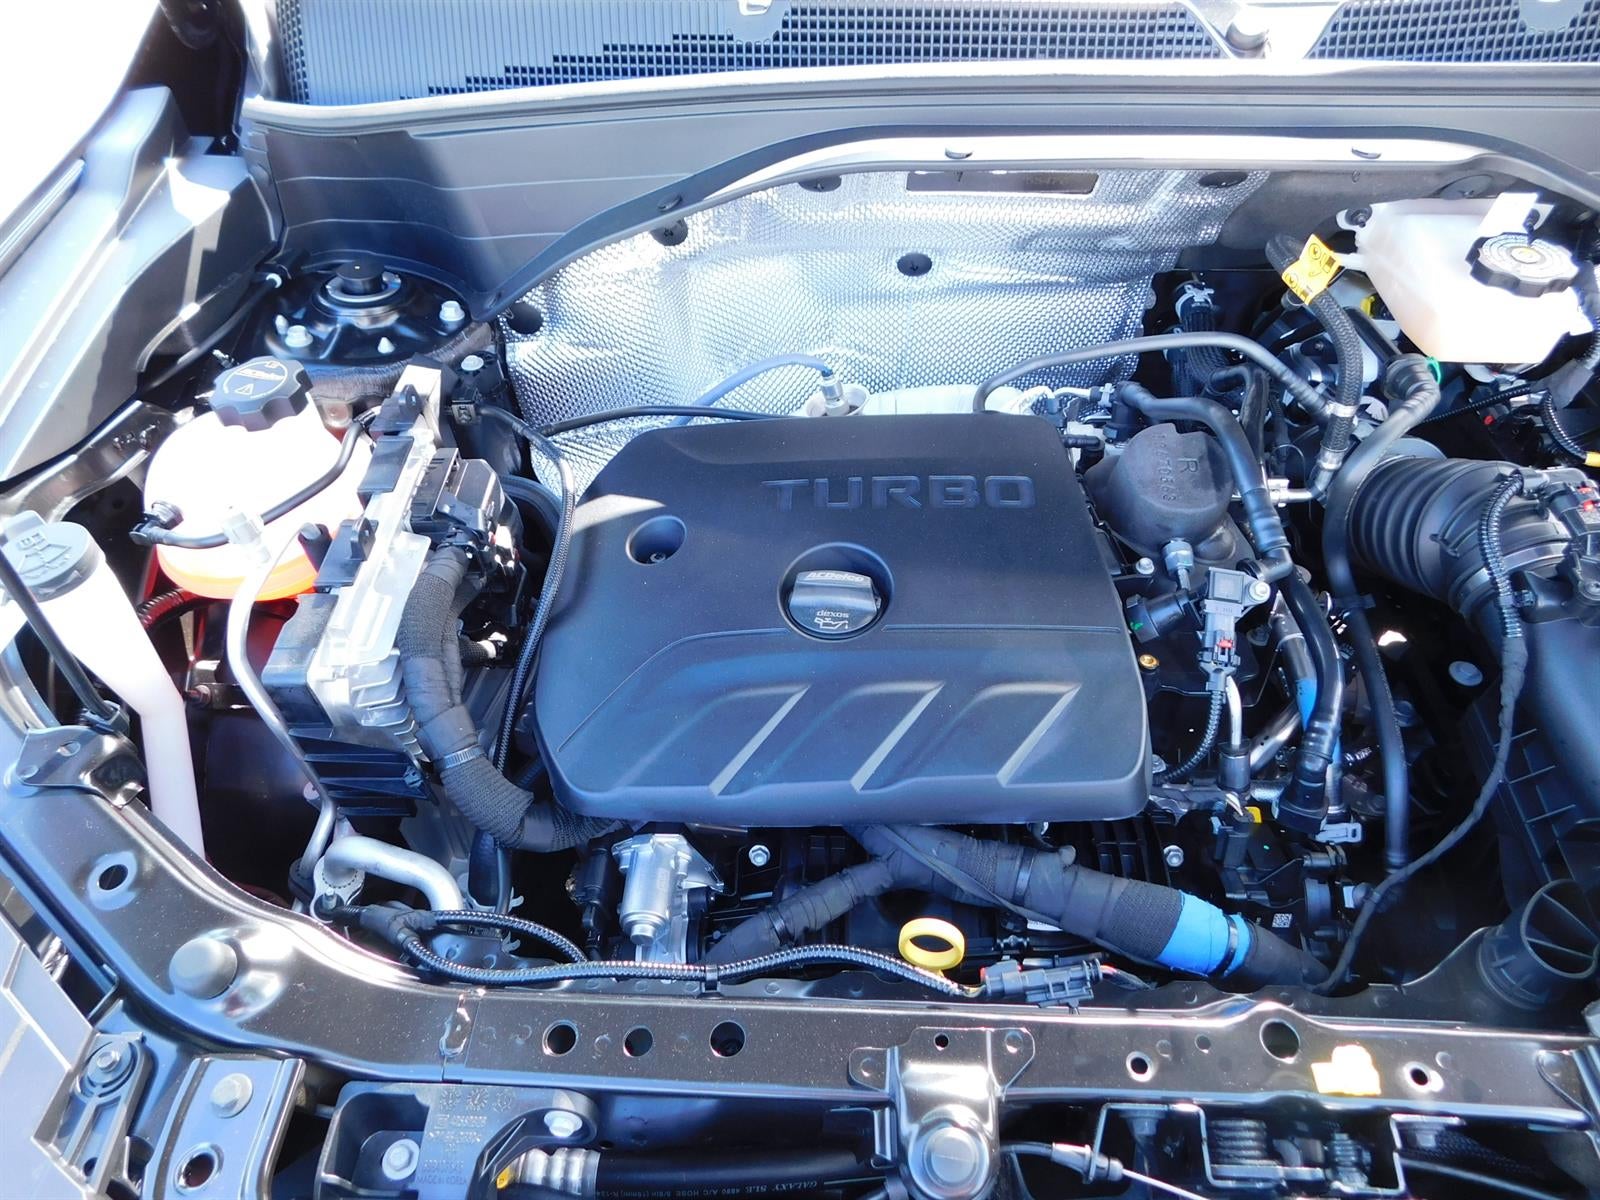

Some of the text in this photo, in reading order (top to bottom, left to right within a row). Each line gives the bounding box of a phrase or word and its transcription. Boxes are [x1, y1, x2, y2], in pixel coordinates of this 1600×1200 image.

[761, 475, 1036, 512] TURBO
[806, 572, 865, 582] ACDelco
[816, 609, 849, 618] dexos
[774, 1180, 818, 1192] GALAXY
